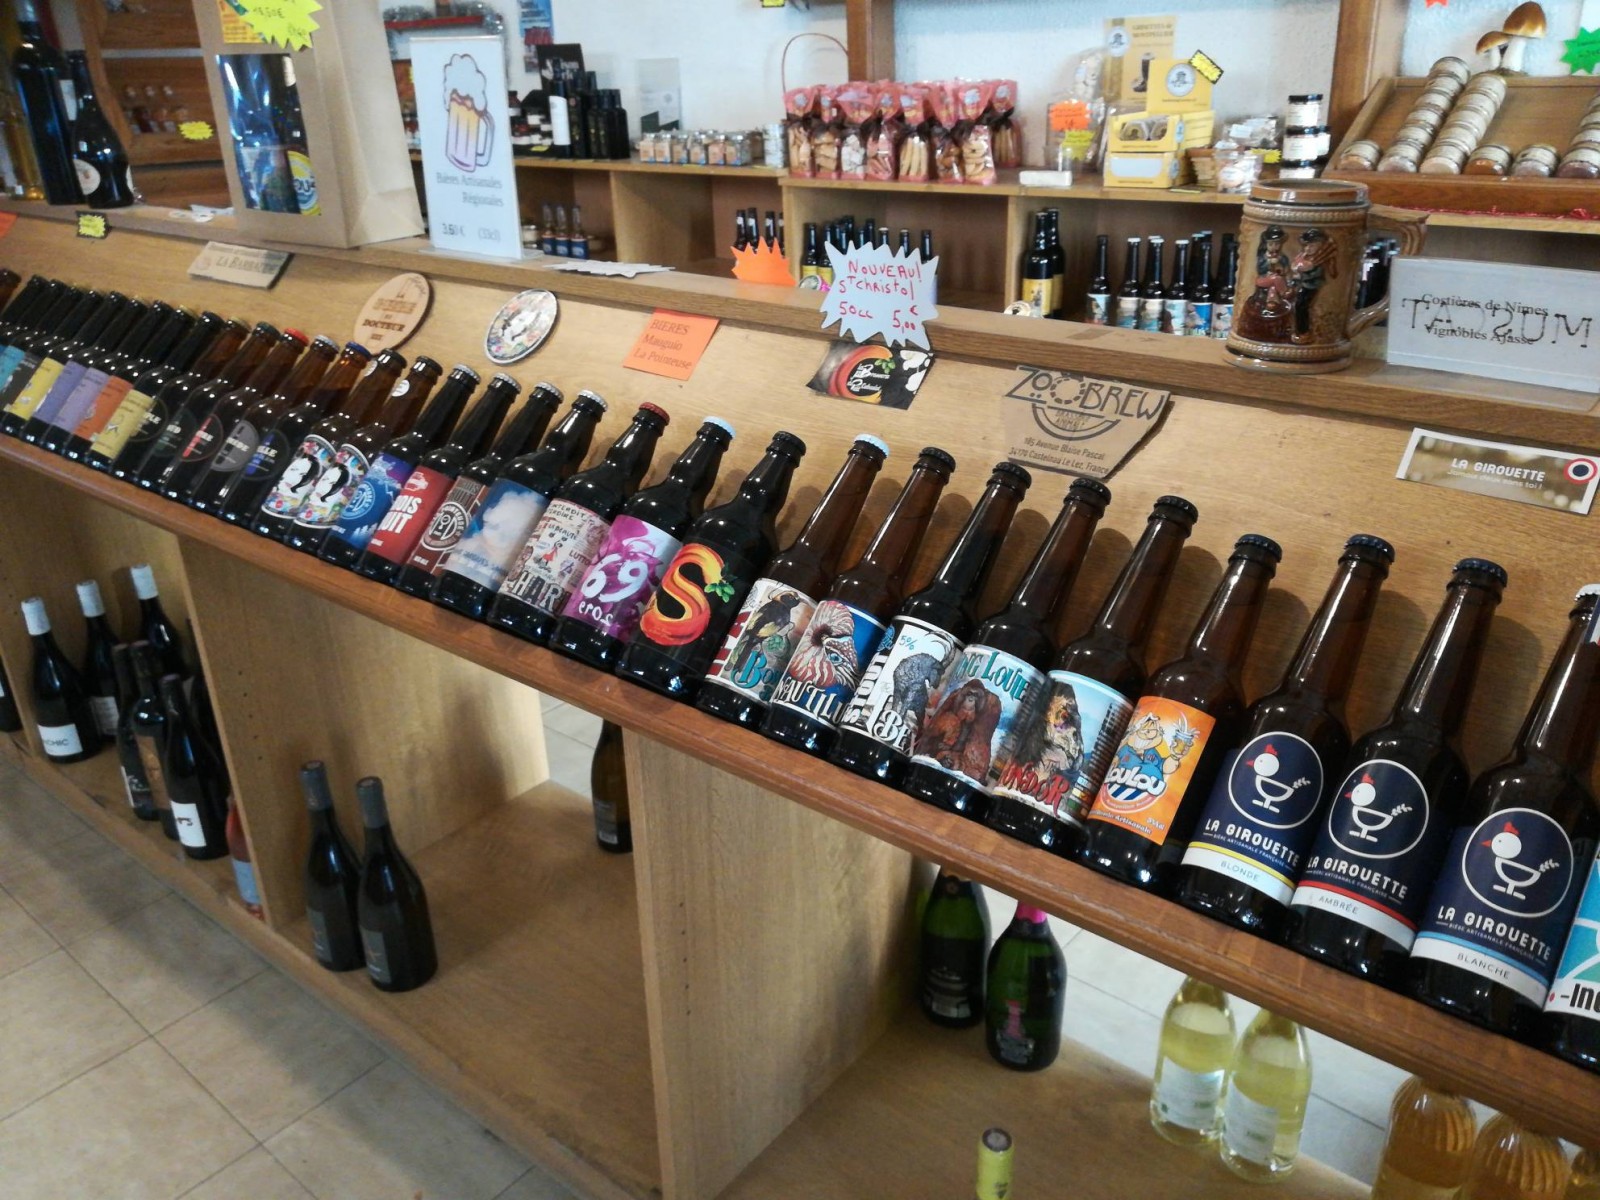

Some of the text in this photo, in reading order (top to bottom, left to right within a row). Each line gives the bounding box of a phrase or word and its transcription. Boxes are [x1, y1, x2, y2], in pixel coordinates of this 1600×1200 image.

[1422, 294, 1482, 309] Costières
[1484, 300, 1499, 312] de
[362, 318, 406, 332] DOCTEUR
[650, 319, 691, 336] BIERES
[1424, 323, 1535, 346] Vignobles Ajasse
[642, 334, 683, 351] Mauguio
[634, 347, 693, 370] La Pointeuse
[1036, 437, 1060, 451] Avenue
[1060, 444, 1082, 456] Blaise
[1082, 448, 1106, 460] Pascal
[1029, 450, 1063, 466] Castelnau
[1062, 457, 1071, 466] Le
[1086, 462, 1110, 475] France
[1450, 458, 1546, 482] LA GIROUETTE
[1502, 479, 1523, 488] sans
[1524, 480, 1537, 489] toi
[580, 553, 648, 603] 69
[578, 601, 614, 627] eros
[898, 635, 918, 651] 5%
[842, 652, 890, 724] STOUT
[981, 650, 1032, 703] LOUIE
[778, 676, 851, 725] NAUTILU
[1205, 818, 1300, 867] LA GIROUETTE
[1228, 838, 1258, 854] ARTISANALE
[1258, 850, 1285, 867] FRANÇAISE
[1220, 860, 1261, 882] BLONDE
[1308, 856, 1408, 899] LA GIROUETTE
[1324, 871, 1356, 885] ARTISANALE
[1356, 880, 1388, 898] FRANÇAISE
[1318, 894, 1360, 915] AMBRÉE
[1438, 906, 1552, 961] LA GIROUETTE
[1466, 928, 1504, 946] ARTISANALE
[1504, 942, 1535, 961] FRANÇAISE
[1457, 952, 1511, 980] BLANCHE
